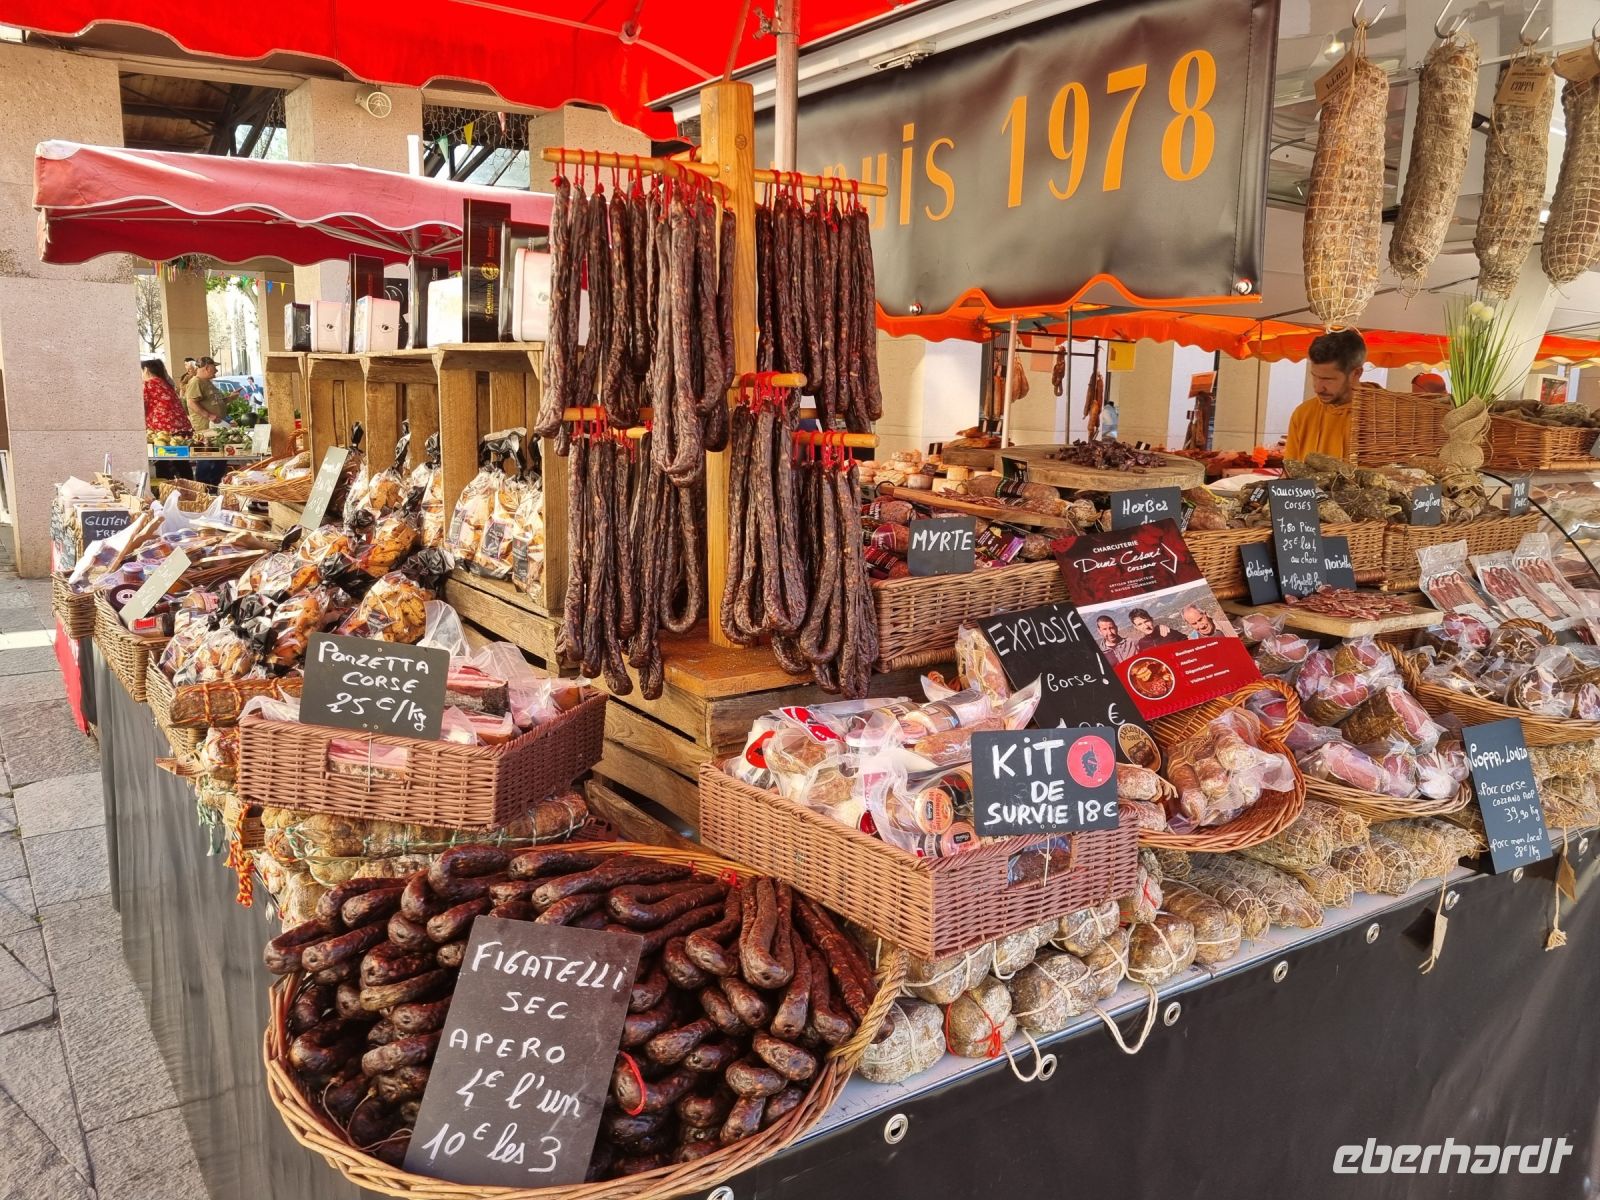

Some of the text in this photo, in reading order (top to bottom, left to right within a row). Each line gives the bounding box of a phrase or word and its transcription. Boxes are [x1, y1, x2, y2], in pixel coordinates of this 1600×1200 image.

[1001, 50, 1216, 208] 1978
[84, 515, 128, 526] GLUTEN
[95, 529, 120, 538] FRE
[911, 530, 973, 552] MYRTE
[1092, 540, 1139, 554] CHARCUTERIE
[1120, 547, 1161, 565] Cesari
[342, 671, 420, 693] CORSE
[1031, 779, 1065, 803] DE
[984, 800, 1118, 827] SURVIE 18€
[501, 991, 569, 1020] SEC
[449, 1028, 566, 1064] APERO
[528, 1136, 562, 1173] 3
